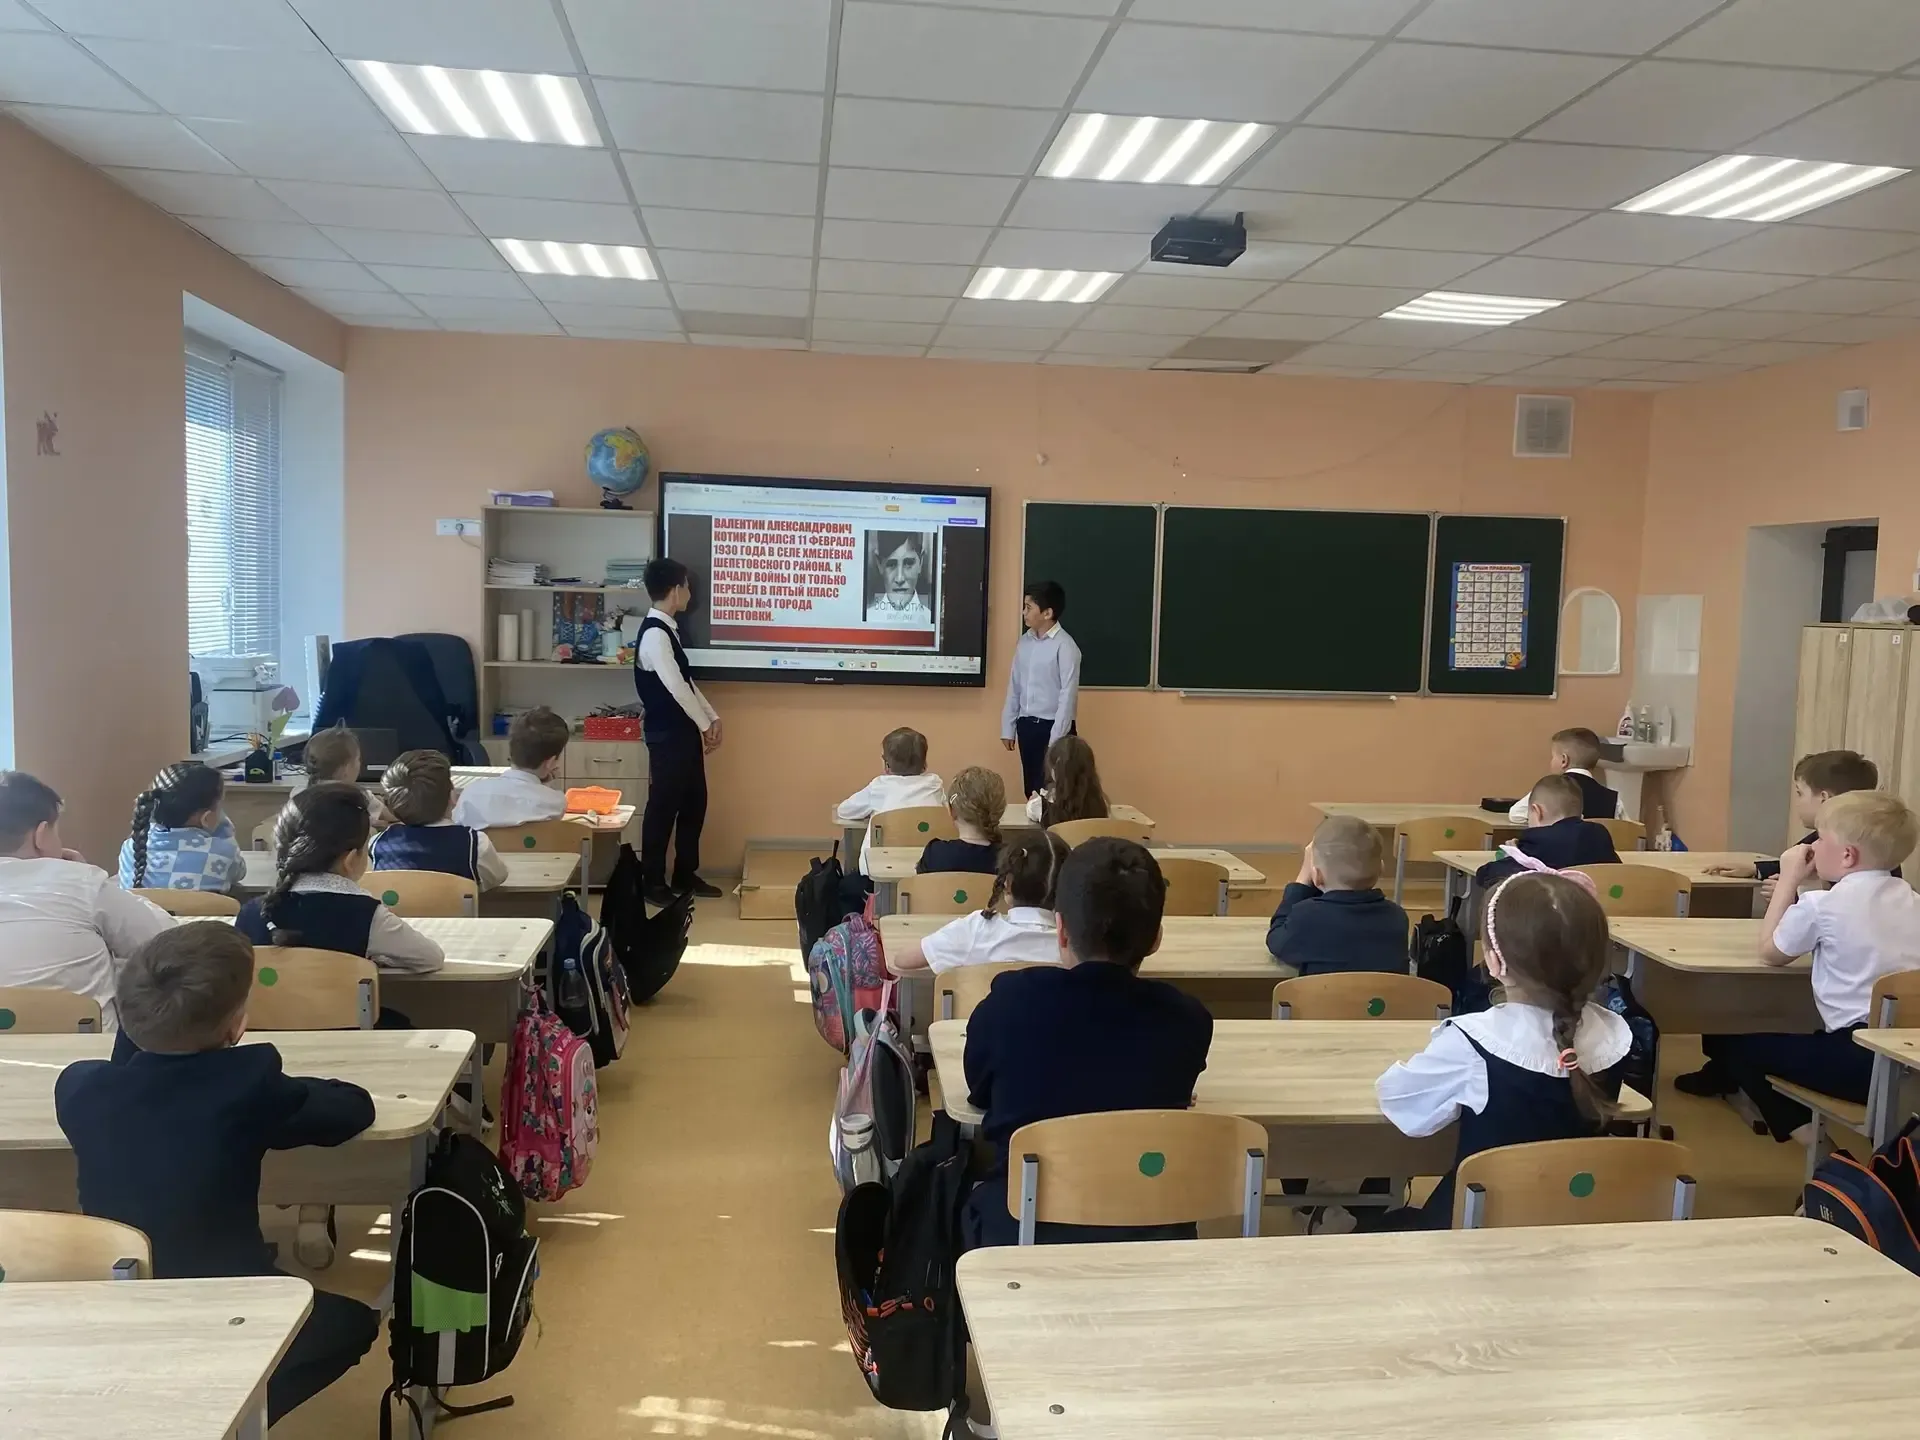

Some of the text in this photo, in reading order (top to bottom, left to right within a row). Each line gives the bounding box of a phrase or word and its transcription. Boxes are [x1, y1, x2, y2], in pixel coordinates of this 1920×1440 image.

[714, 518, 852, 534] ВАЛЕНТИН АЛЕКСАНДРОВИЧ
[714, 531, 856, 547] КОТИК РОДИЛСЯ 11 ФЕВРАЛЯ
[714, 544, 853, 560] 1930 ГОДА В СЕЛЕ ХМЕЛЁВКА
[714, 558, 842, 572] ШЕПЕТОВСКОГО РАЙОНА. К
[714, 570, 846, 585] НАЧАЛУ ВОЙНЫ ОН ТОЛЬКО
[714, 583, 839, 598] ПЕРЕШЁЛ В ПЯТЫЙ КЛАСС
[713, 596, 812, 611] ШКОЛЫ №4 ГОРОДА
[713, 610, 774, 622] ШЕПЕТОВКИ.
